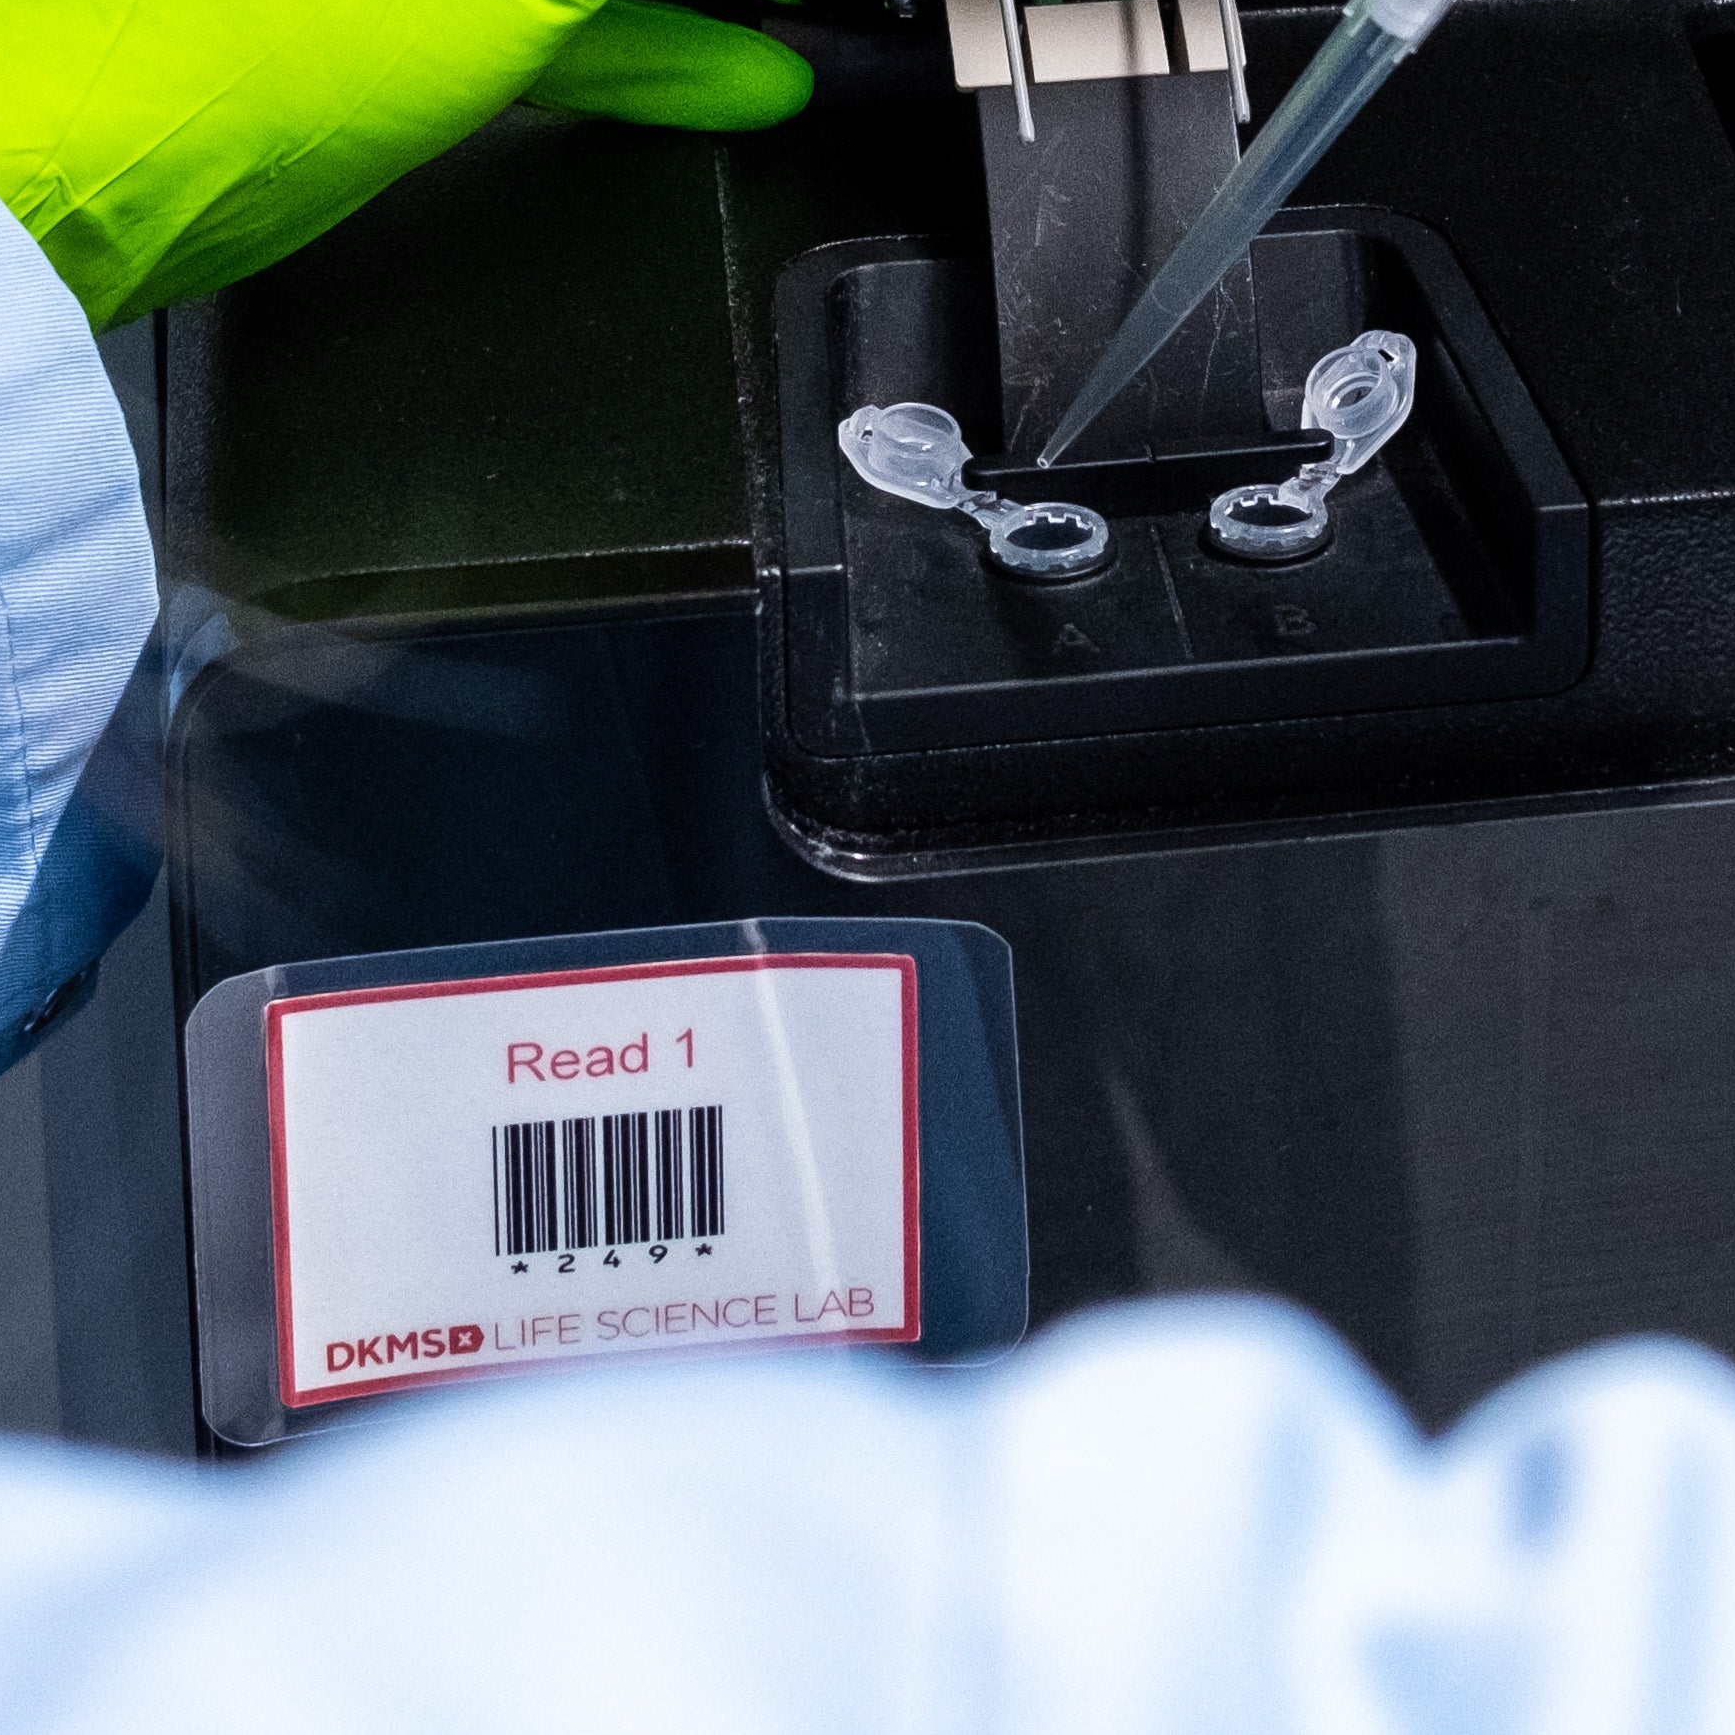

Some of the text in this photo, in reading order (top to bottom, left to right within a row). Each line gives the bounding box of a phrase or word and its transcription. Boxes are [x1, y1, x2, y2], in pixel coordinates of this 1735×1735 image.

[508, 1028, 695, 1083] Read 1
[326, 1288, 874, 1373] DKMS LIFE SCIENCE LAB
